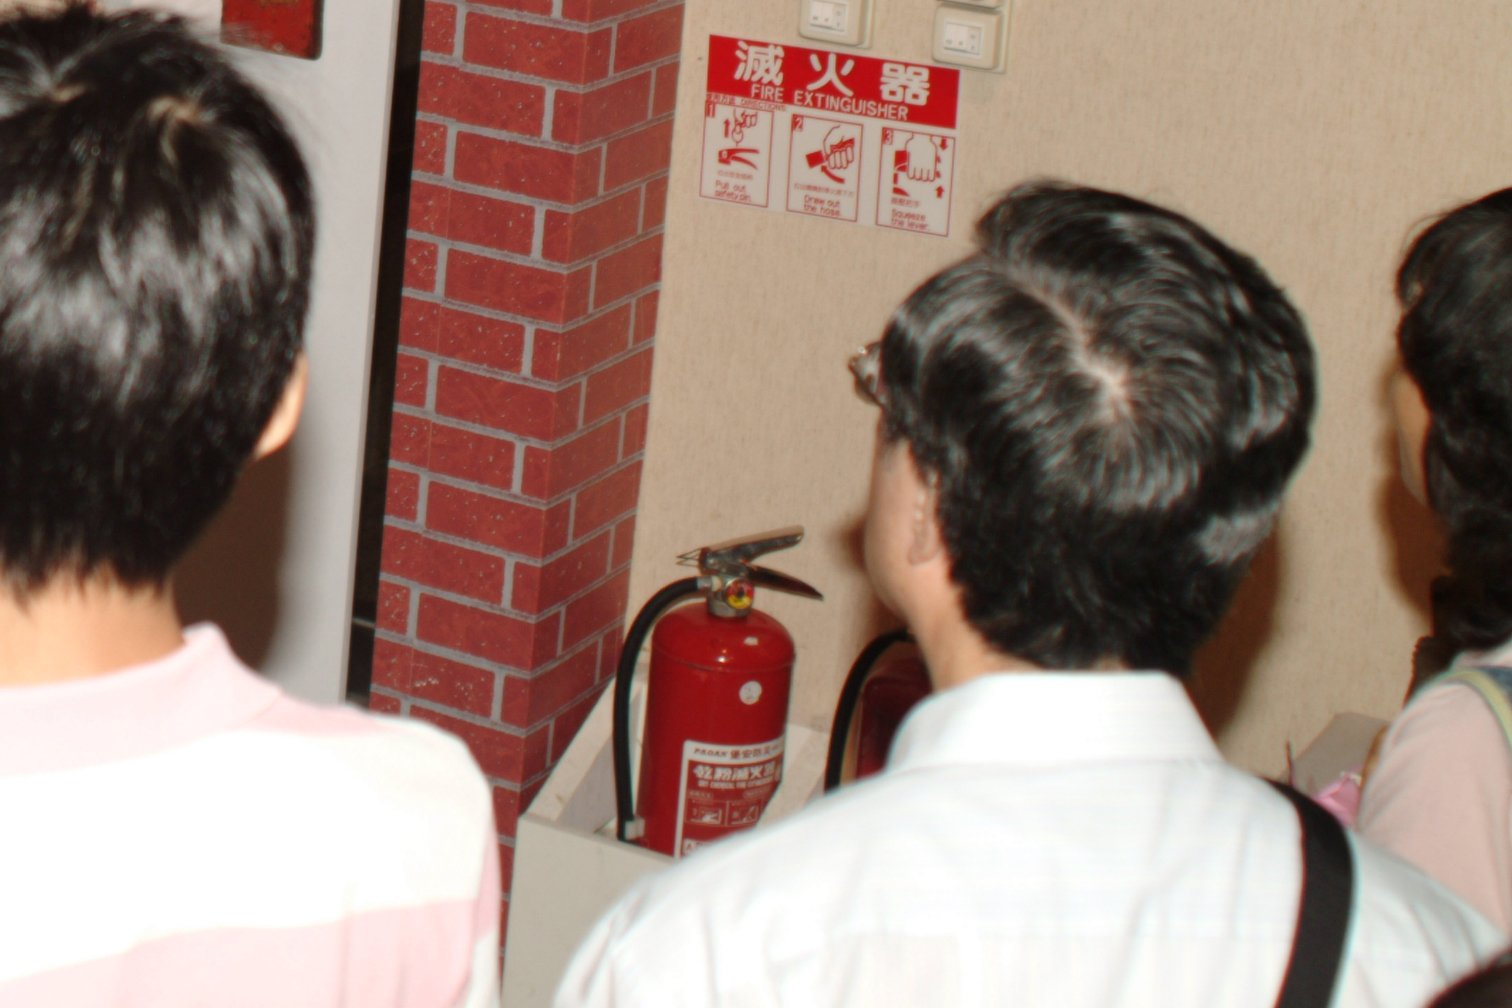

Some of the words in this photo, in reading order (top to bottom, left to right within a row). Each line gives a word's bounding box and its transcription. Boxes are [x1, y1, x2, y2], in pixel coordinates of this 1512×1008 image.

[734, 41, 930, 106] 滅火器
[751, 84, 784, 103] FIRE
[794, 90, 909, 121] EXTINGUISHER
[892, 208, 926, 222] Squeeze
